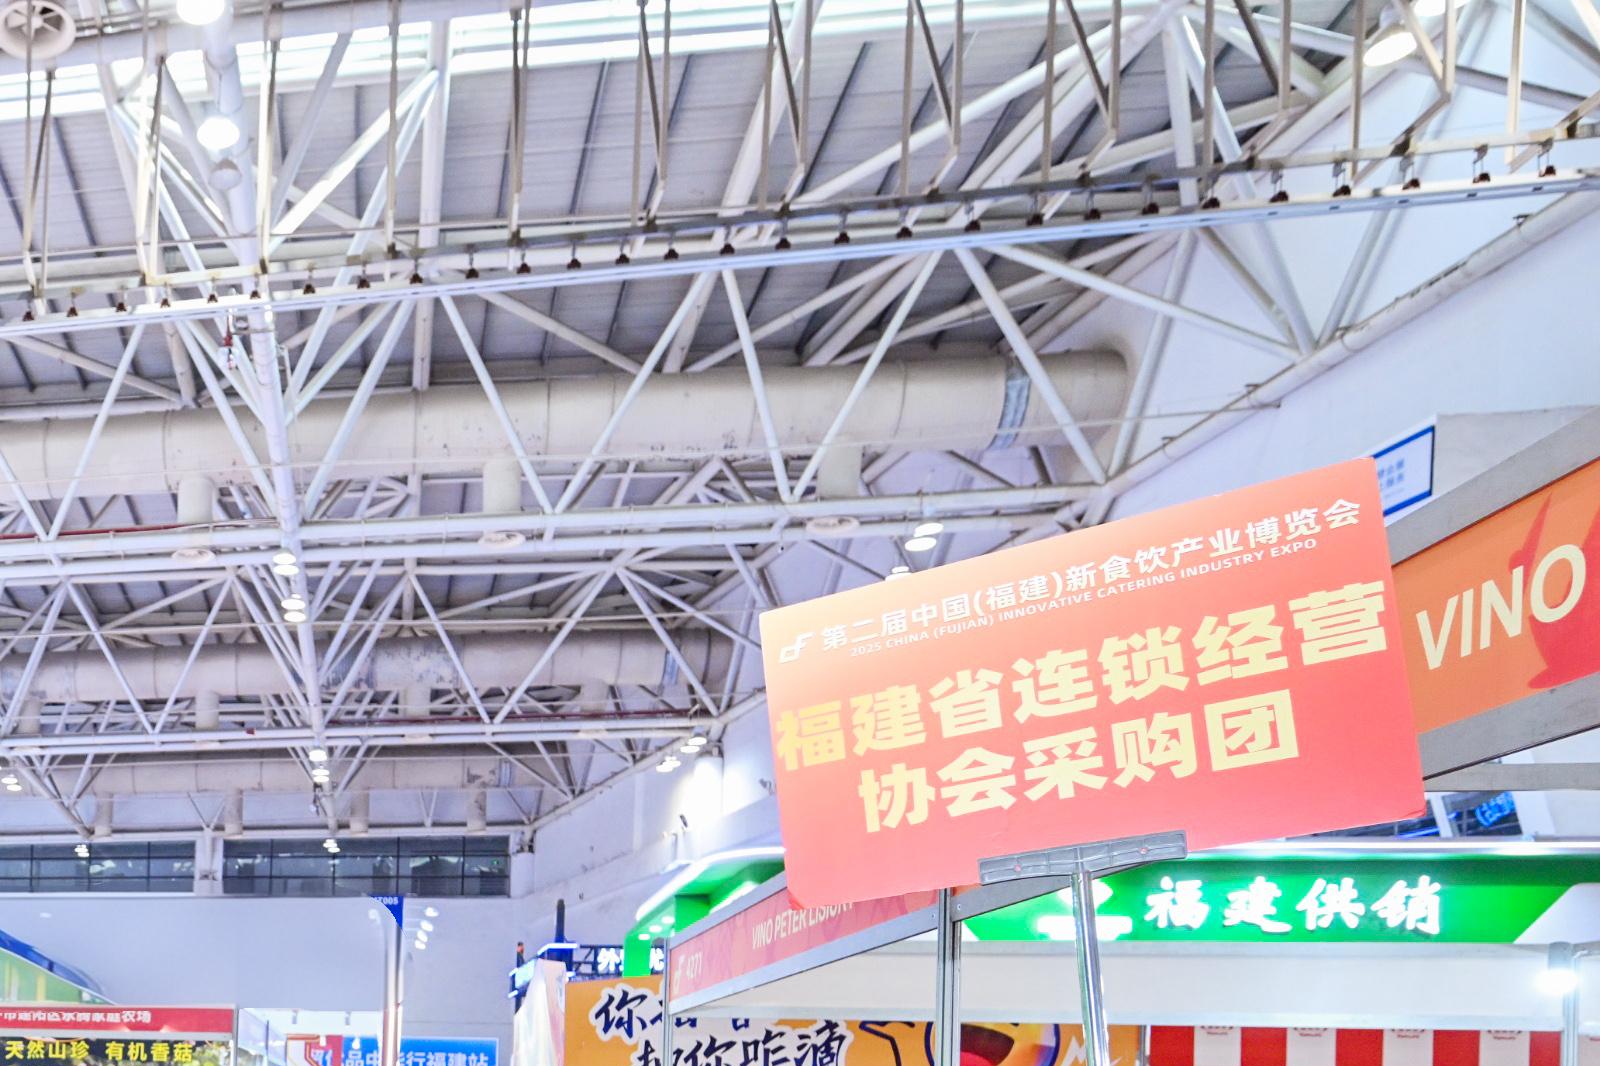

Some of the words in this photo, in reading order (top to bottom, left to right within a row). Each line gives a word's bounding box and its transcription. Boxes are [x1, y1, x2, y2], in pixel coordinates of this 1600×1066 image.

[821, 498, 1361, 651] 第二届中国(福建)新食饮产业博览会
[850, 643, 880, 657] 2025
[880, 631, 929, 651] CHINA
[933, 613, 994, 641] (FUJIAN)
[997, 592, 1093, 622] INNOVATIVE
[1096, 572, 1176, 600] CATERING
[1179, 551, 1266, 579] INDUSTRY
[1269, 538, 1317, 561] EXPO
[1416, 544, 1586, 670] VINO
[776, 579, 1387, 771] 福建省连锁经营
[857, 688, 1299, 832] 协会采购团
[751, 920, 774, 949] VINO
[1144, 875, 1442, 936] 福建供销
[5, 1040, 90, 1060] 天然山珍
[105, 1042, 193, 1063] 有机香菇
